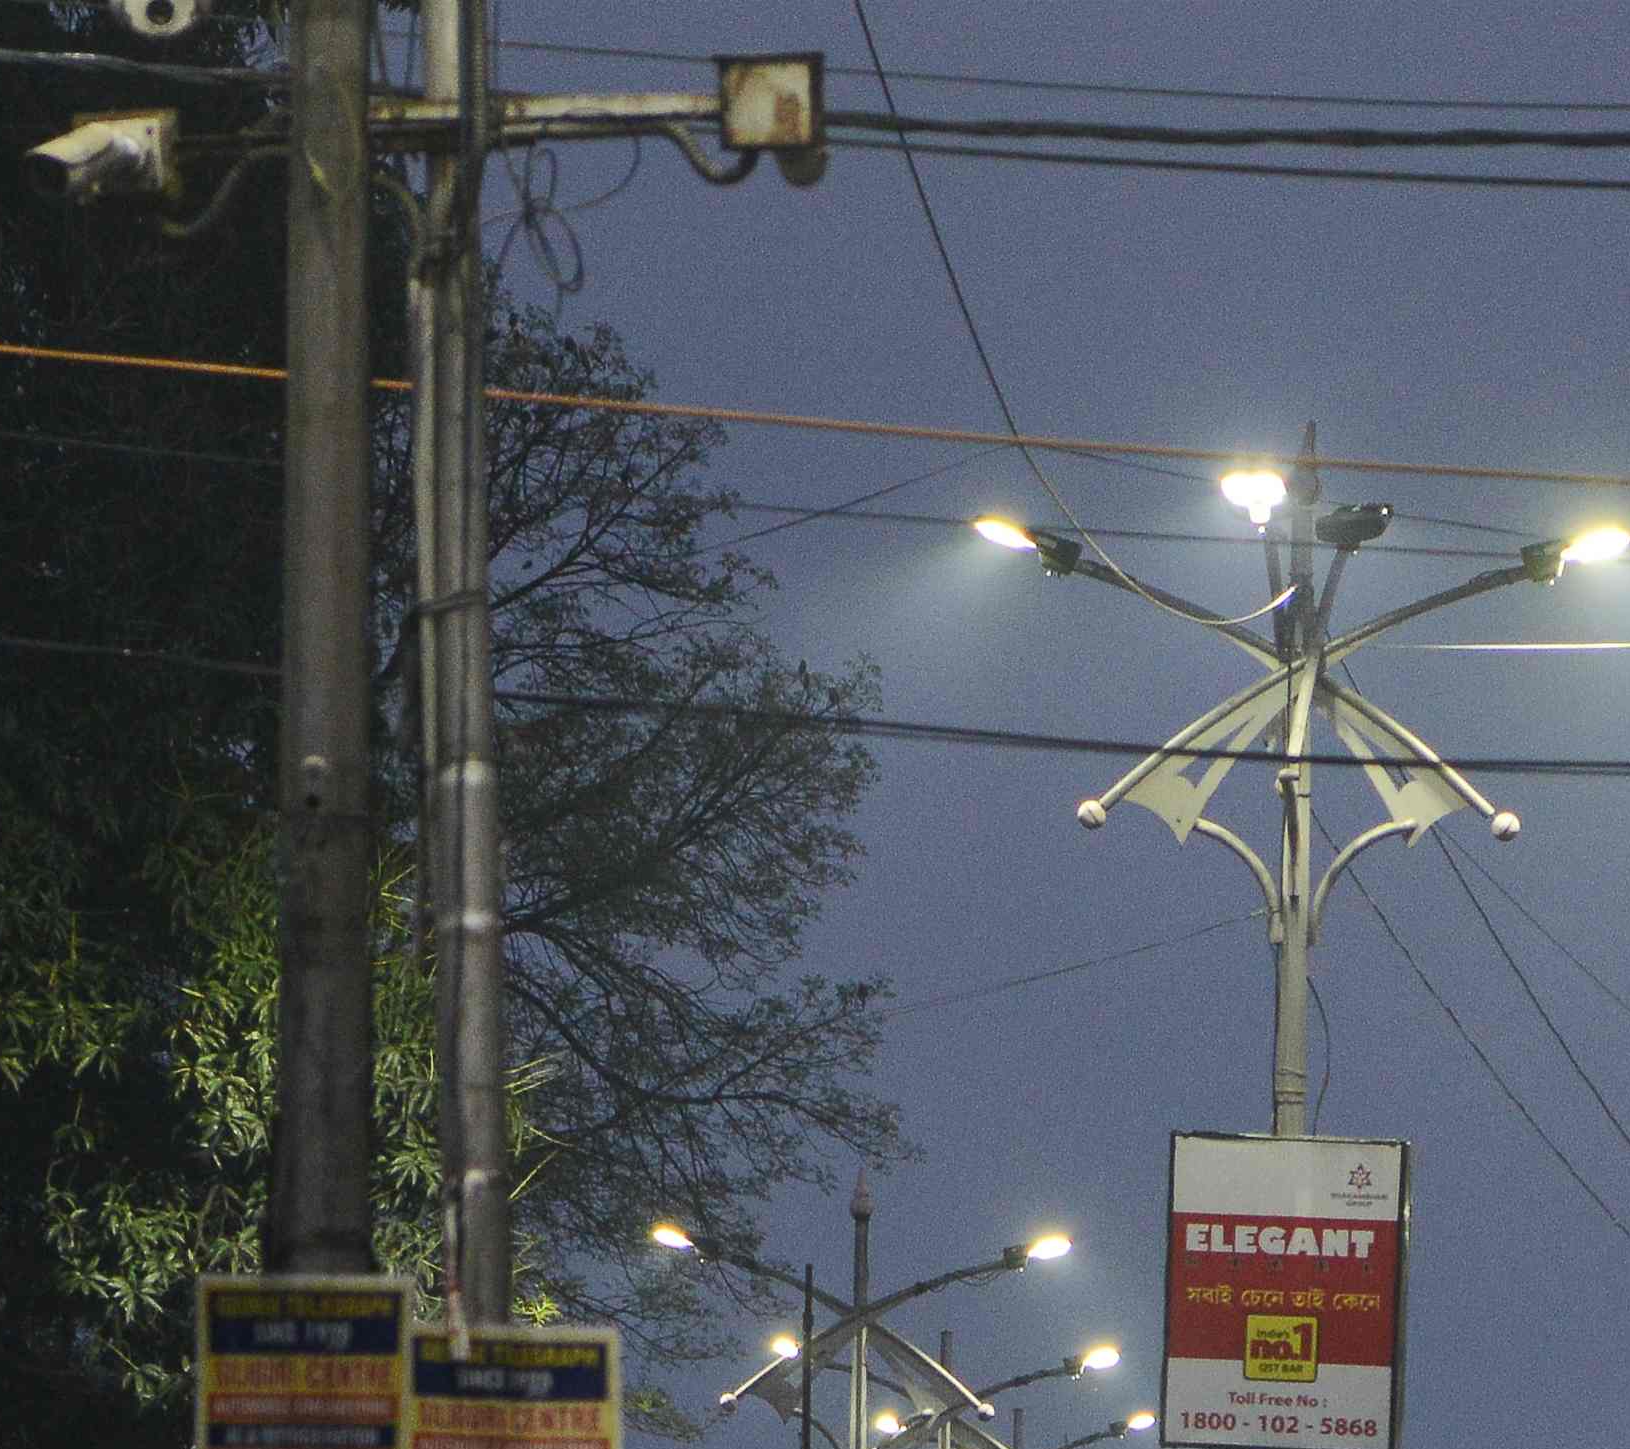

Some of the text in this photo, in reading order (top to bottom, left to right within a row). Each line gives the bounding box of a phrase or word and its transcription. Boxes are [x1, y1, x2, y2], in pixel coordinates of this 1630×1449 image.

[1185, 1223, 1375, 1258] ELEGANT
[1185, 1284, 1381, 1312] সবাই চেনে তাই কেনে
[1228, 1391, 1257, 1405] Toll
[1259, 1392, 1294, 1407] Free
[1296, 1393, 1320, 1408] No
[1181, 1410, 1236, 1431] 1800
[1258, 1415, 1299, 1434] 102
[1321, 1416, 1378, 1438] 5868
